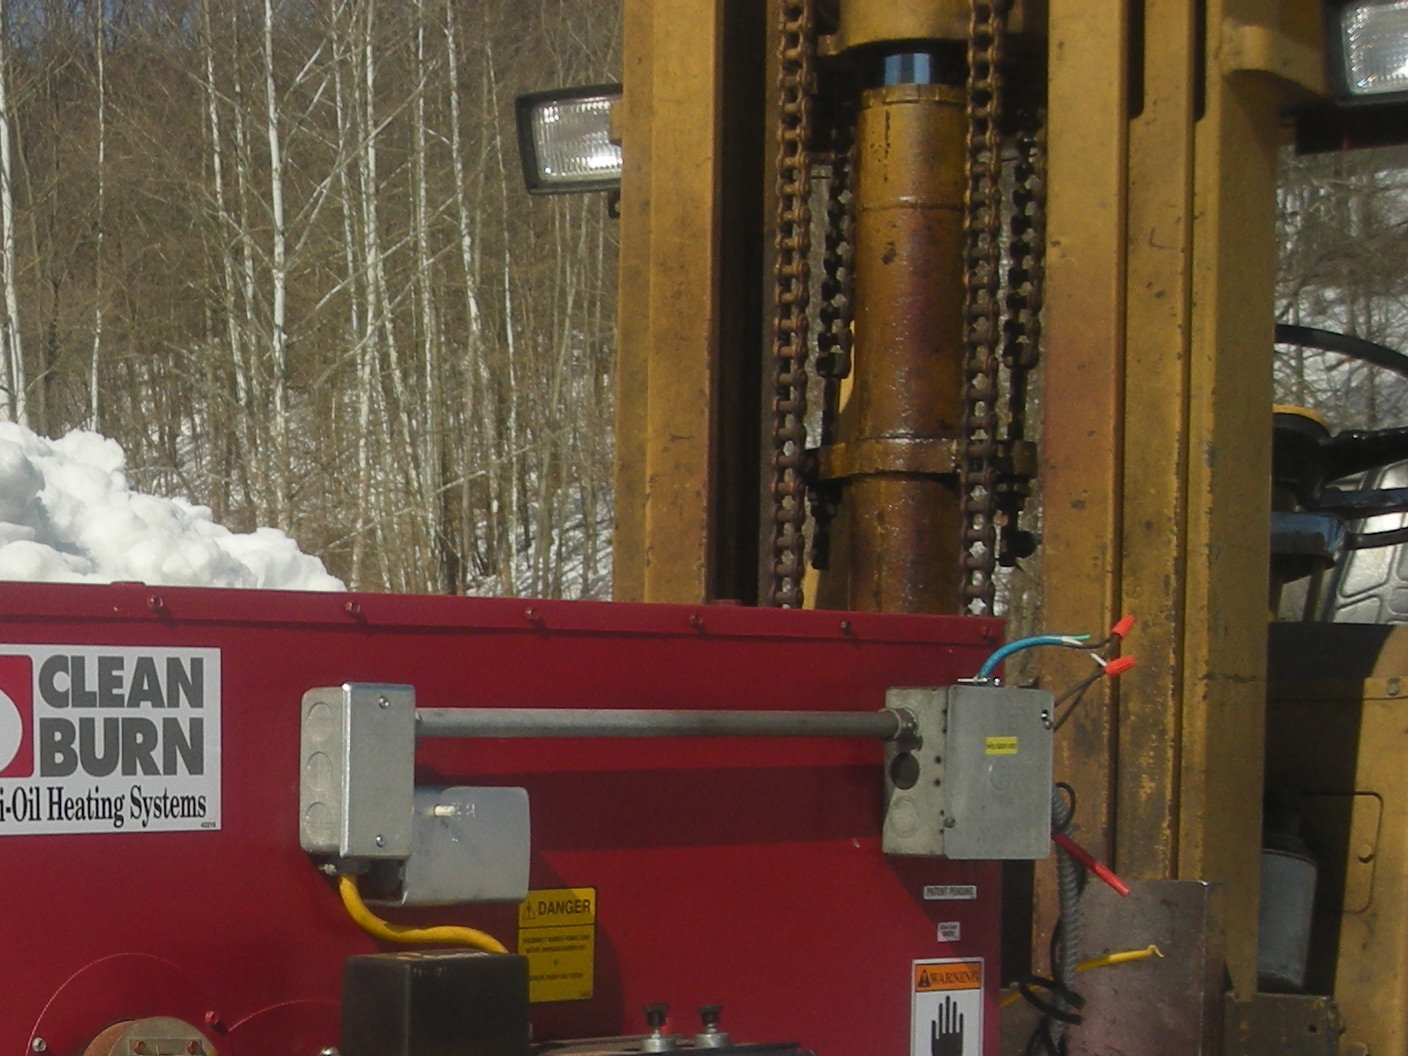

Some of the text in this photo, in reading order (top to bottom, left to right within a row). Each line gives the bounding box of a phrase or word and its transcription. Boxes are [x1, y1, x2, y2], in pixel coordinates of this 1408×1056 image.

[39, 654, 204, 708] CLEAN
[39, 717, 204, 777] BURN
[47, 786, 126, 828] Heating
[130, 785, 206, 827] Systems
[538, 899, 591, 915] DANGER
[930, 970, 979, 984] WARNING
